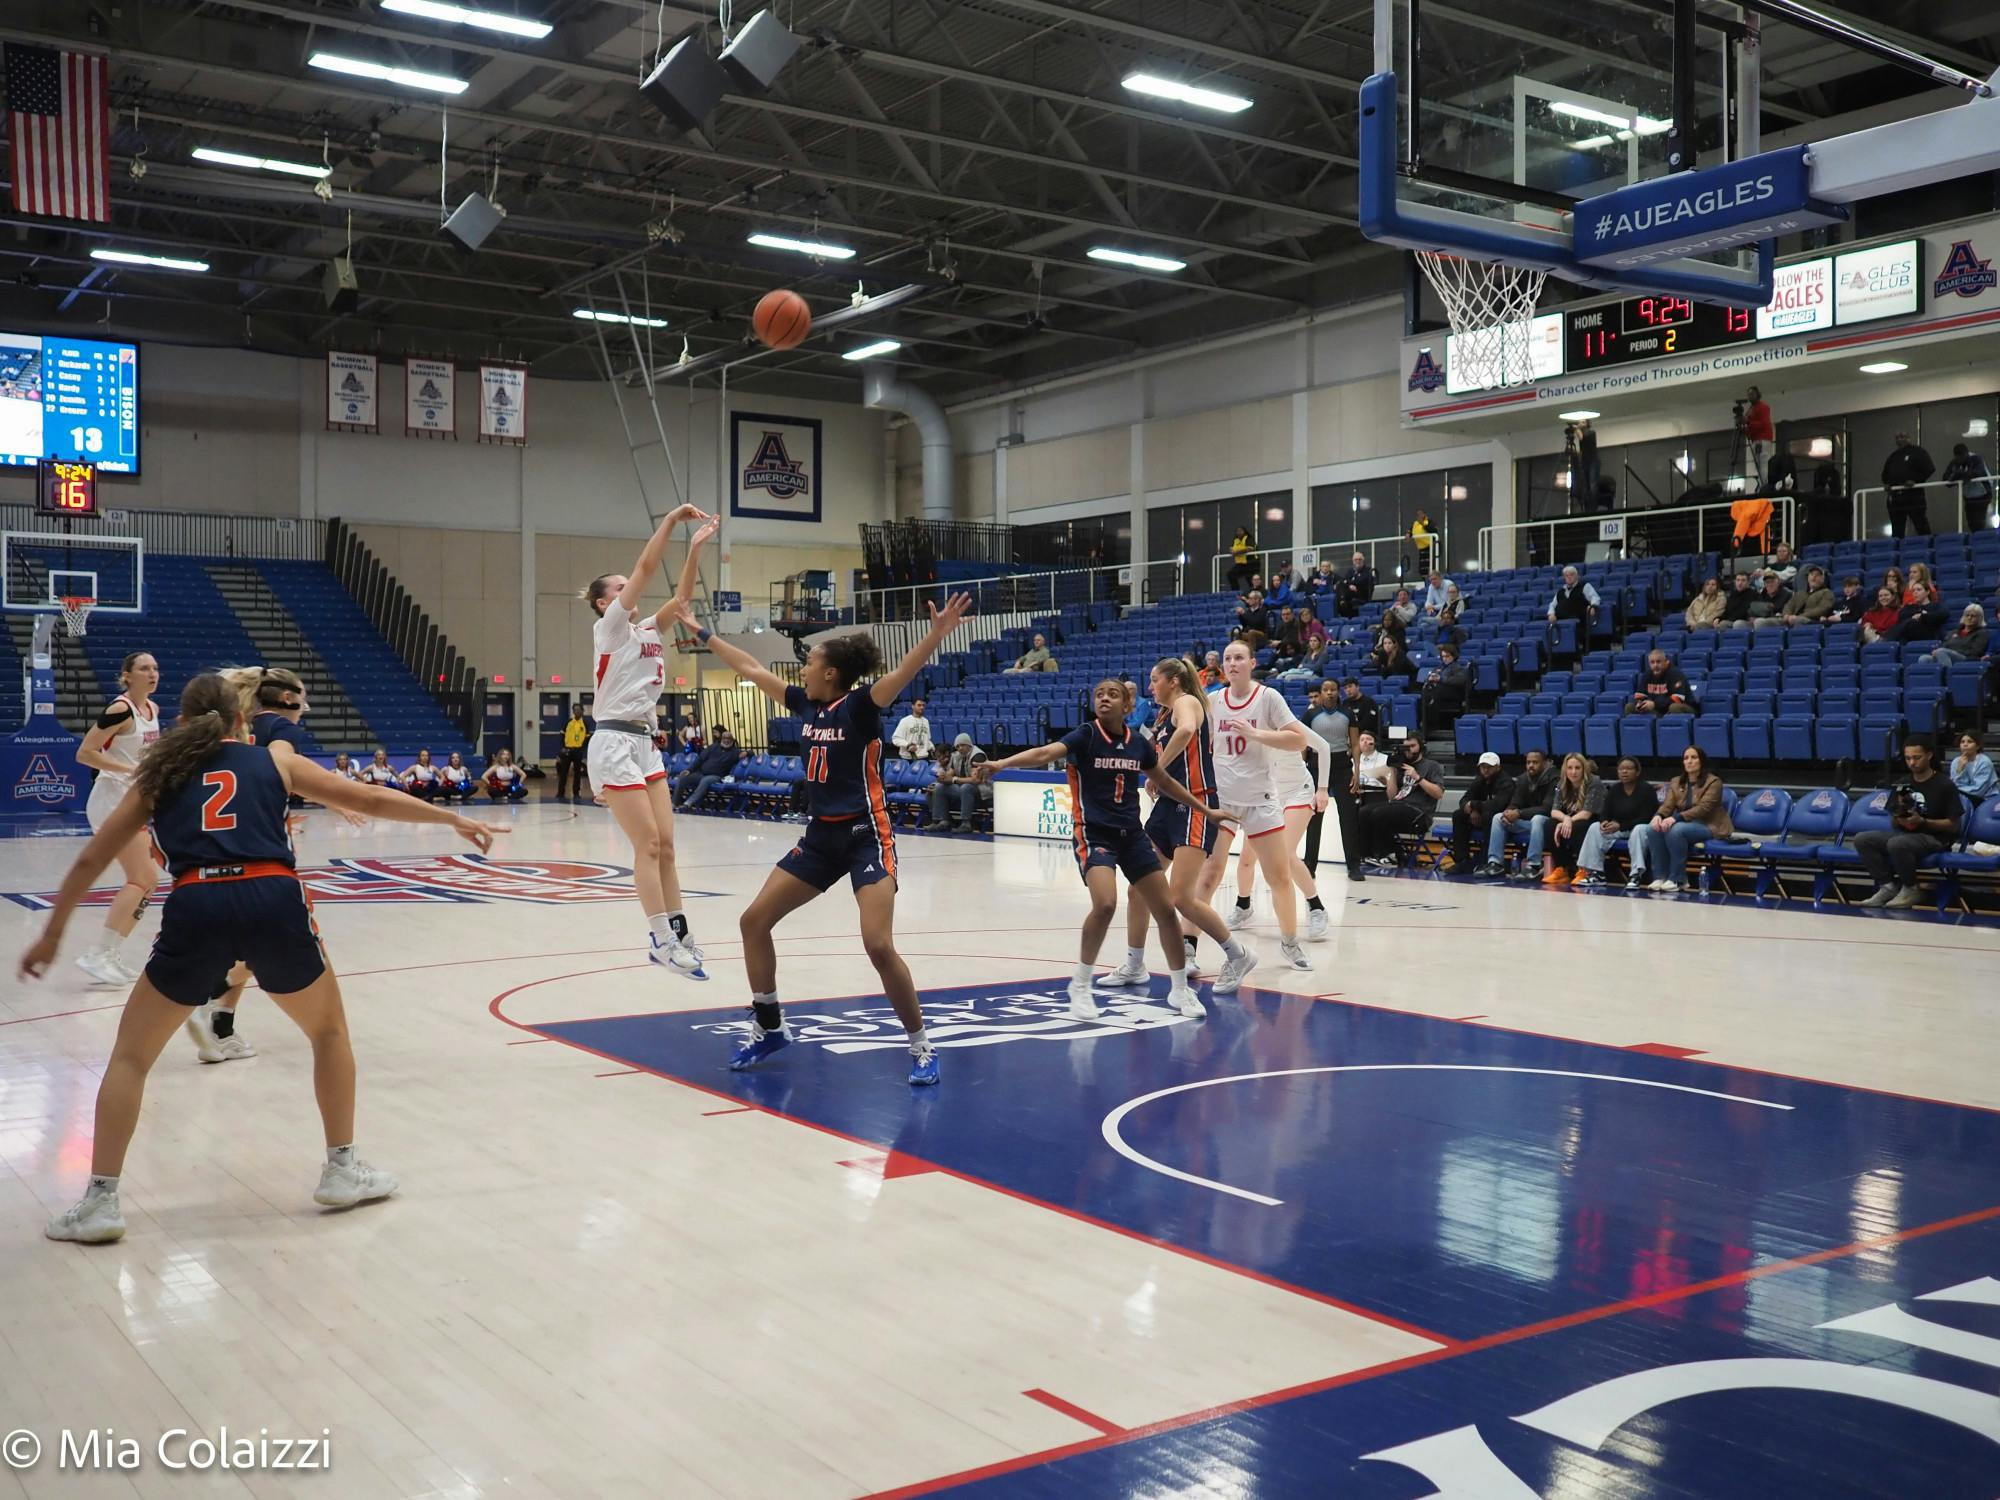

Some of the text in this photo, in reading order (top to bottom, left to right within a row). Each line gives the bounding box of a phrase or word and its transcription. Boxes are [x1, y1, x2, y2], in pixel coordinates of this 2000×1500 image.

[1594, 175, 1774, 241] #AUEAGLES
[1806, 267, 1824, 282] THE
[1870, 274, 1910, 292] CLUB
[1940, 274, 1993, 291] AMERICAN
[1766, 283, 1824, 313] AGLES
[1640, 296, 1690, 325] 9:24
[1575, 313, 1603, 330] HOME
[1585, 330, 1605, 359] 11
[1630, 337, 1658, 352] PERIOD
[1665, 329, 1676, 351] 2
[331, 362, 374, 372] BASKETBALL
[411, 370, 451, 379] BASKETBALL
[1539, 345, 1804, 400] Character Forged Through Competition
[484, 377, 521, 386] BASKETBALL
[121, 387, 133, 430] BISON
[70, 427, 102, 452] 13
[55, 464, 92, 481] 9:24
[749, 473, 804, 487] AMERICAN
[60, 481, 86, 508] 16
[1604, 523, 1619, 535] 103
[1303, 553, 1313, 564] 102
[14, 736, 74, 744] AUeagles.com
[1225, 735, 1247, 755] 10
[807, 745, 829, 783] 11
[18, 785, 72, 795] AMERICAN
[1114, 773, 1125, 804] 1
[202, 769, 237, 832] 2
[1038, 811, 1074, 824] PATRI
[1038, 824, 1073, 835] LEAG
